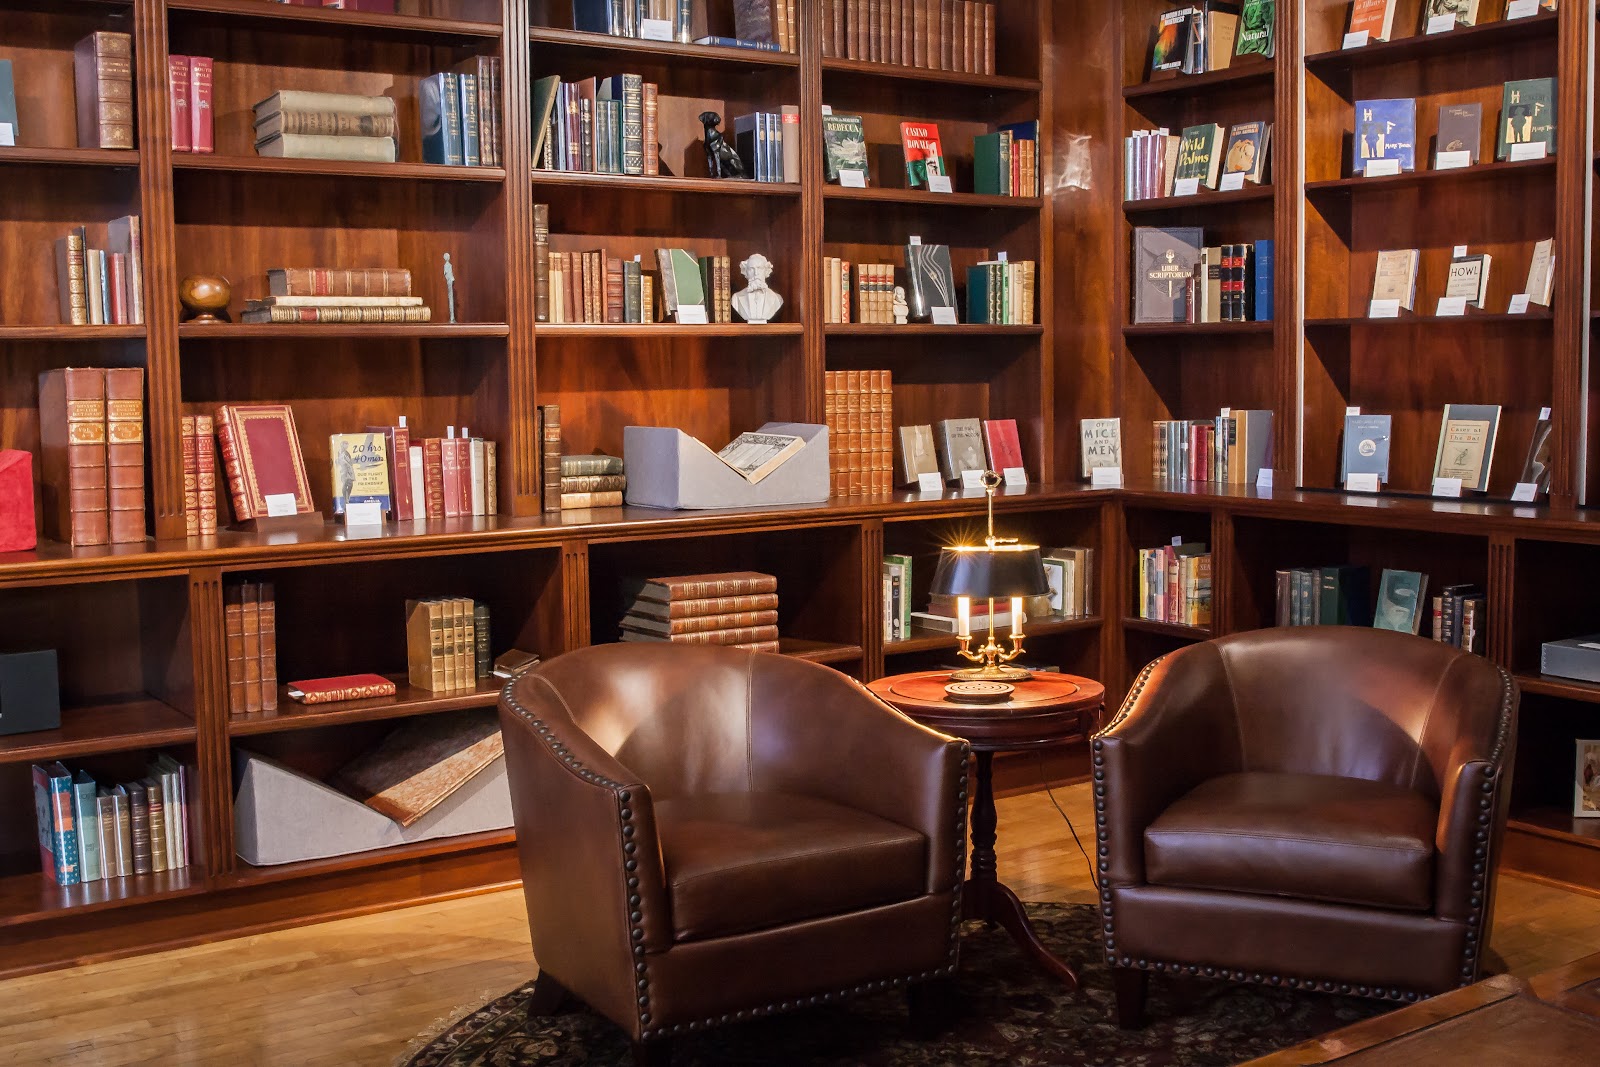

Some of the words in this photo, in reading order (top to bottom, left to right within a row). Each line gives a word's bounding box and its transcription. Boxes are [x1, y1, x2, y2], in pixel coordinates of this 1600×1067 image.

[1241, 27, 1269, 41] Natural
[1510, 90, 1520, 104] H
[1363, 108, 1373, 122] H
[1535, 102, 1544, 117] F
[827, 122, 860, 133] REBECCA
[905, 127, 928, 137] CASINO
[1386, 120, 1396, 134] F
[1180, 136, 1205, 152] Wild
[1179, 151, 1210, 166] Palms
[1149, 272, 1192, 280] SCRIPTORUM
[1451, 266, 1479, 277] HOWL
[1085, 429, 1117, 439] MICE
[352, 445, 365, 453] 20
[367, 442, 384, 452] hrs.
[1088, 445, 1115, 455] MEN
[354, 454, 368, 463] 40
